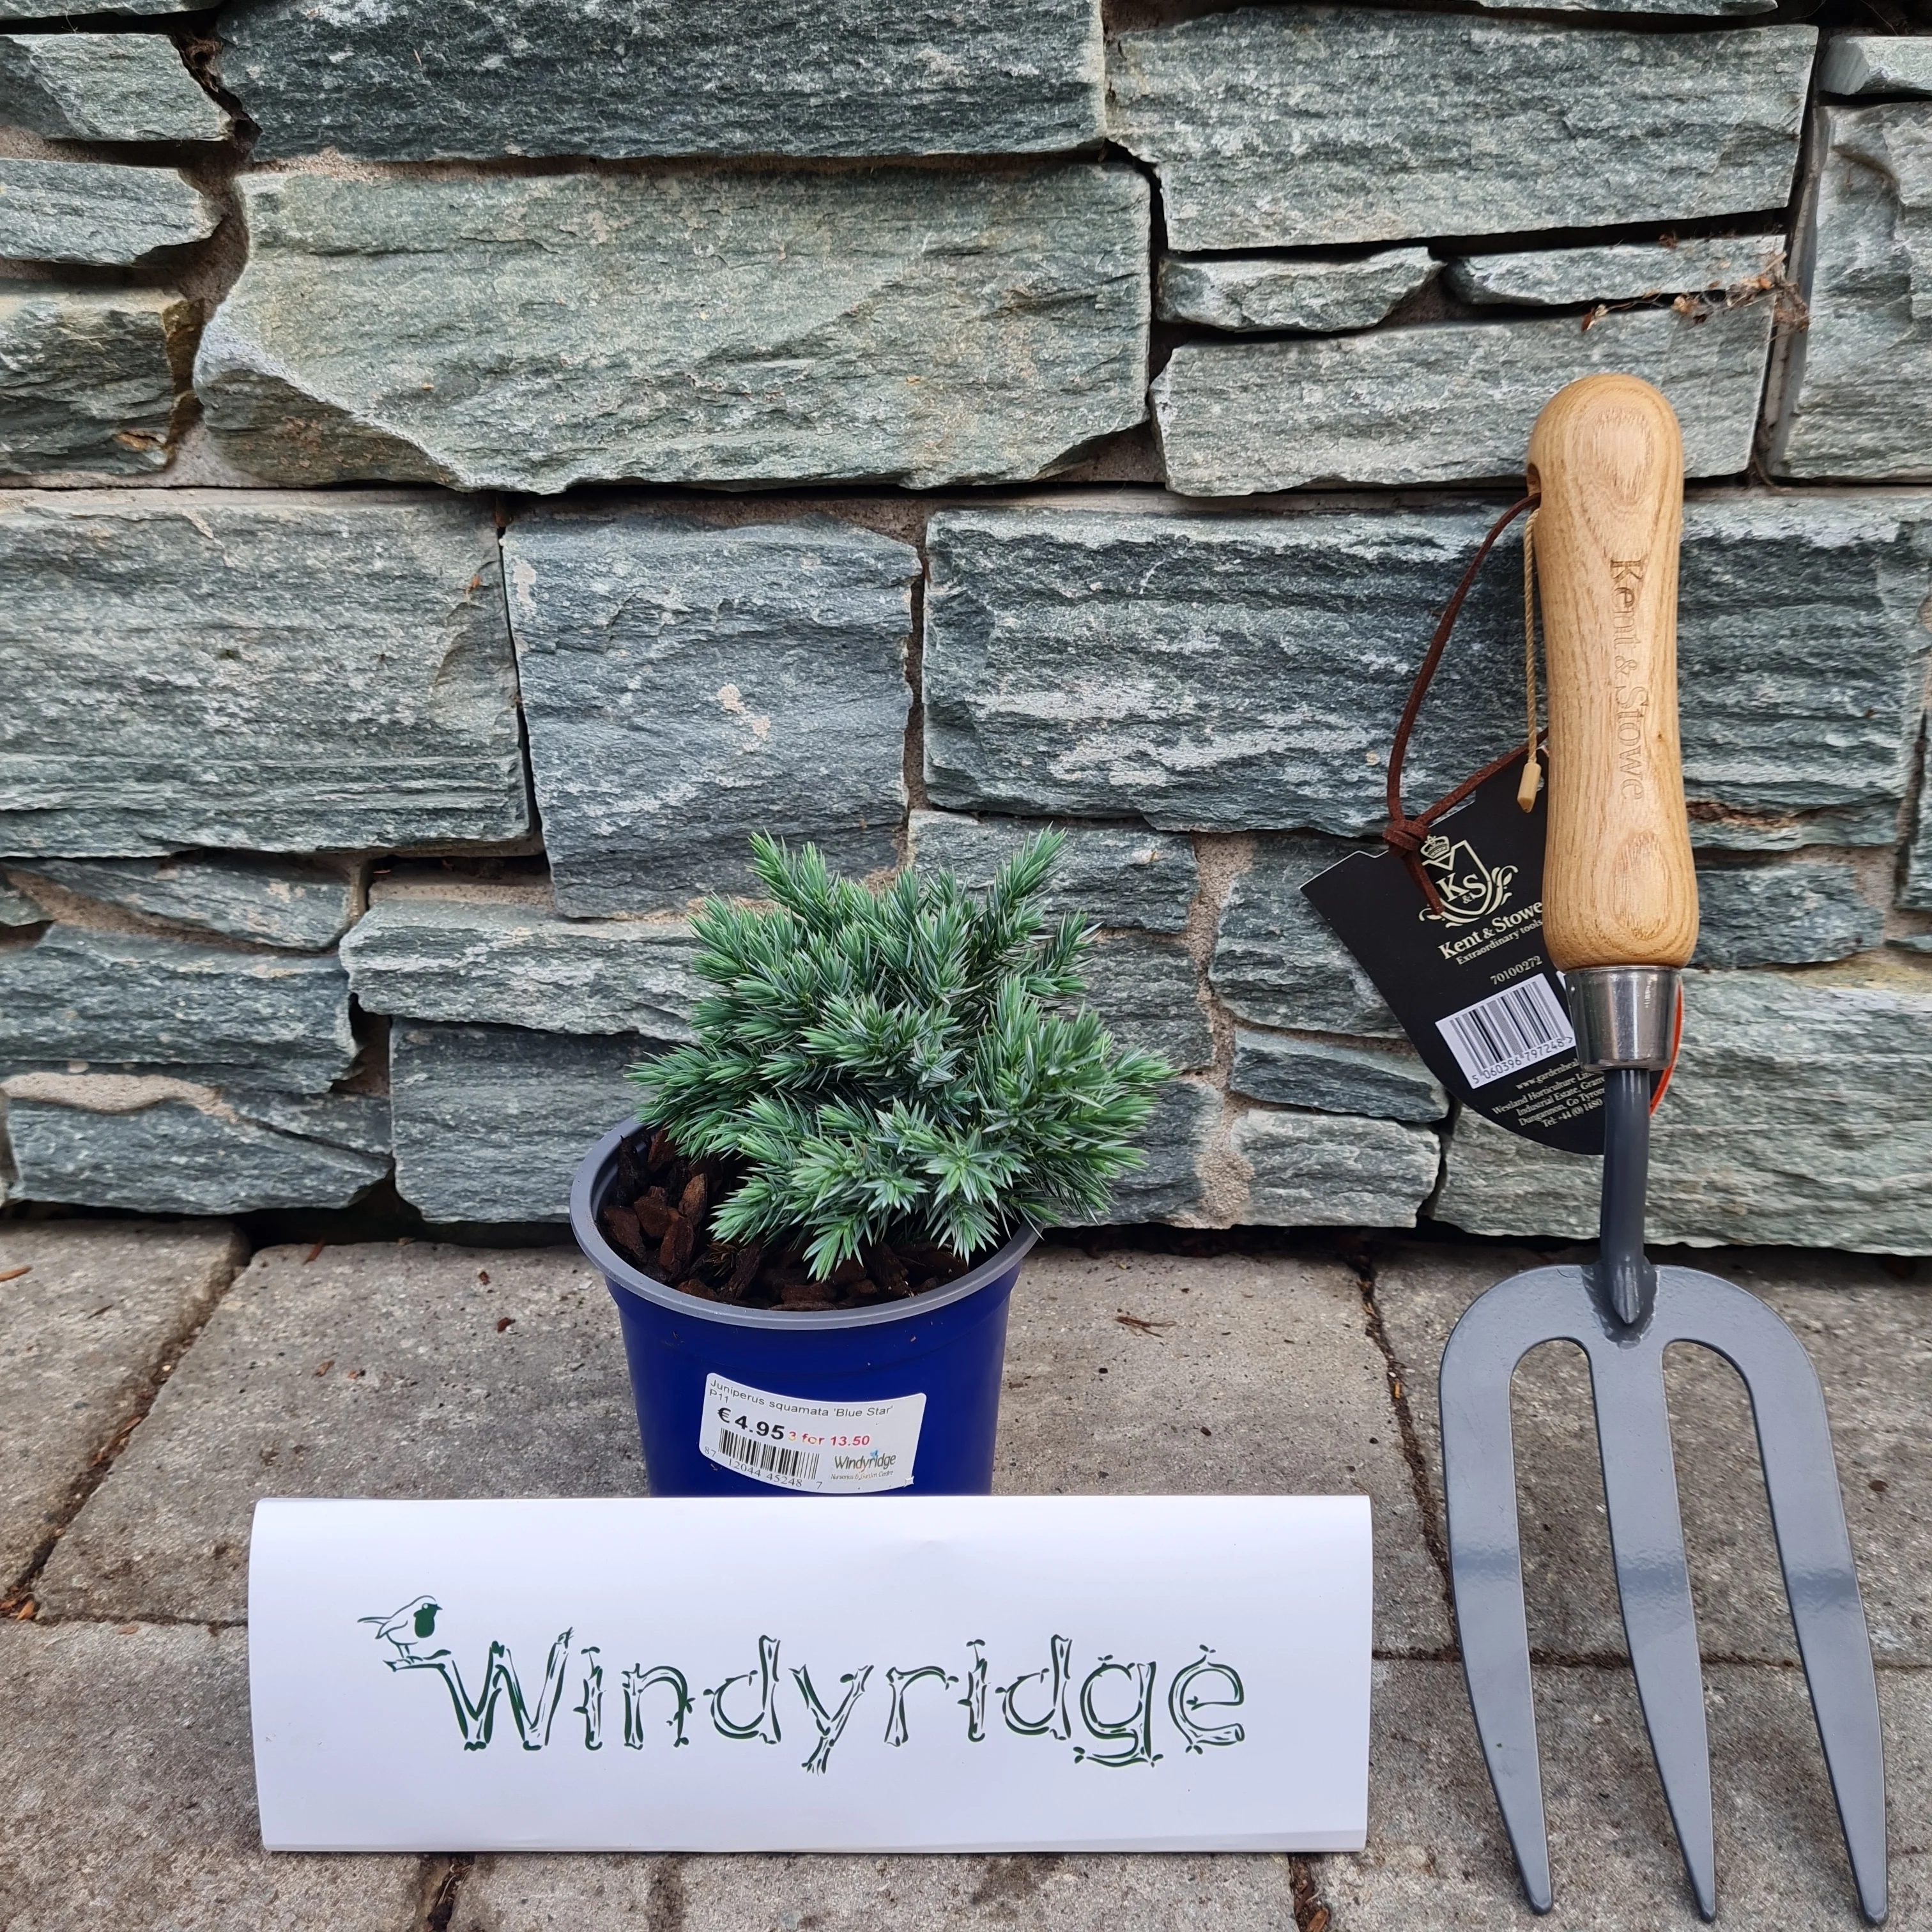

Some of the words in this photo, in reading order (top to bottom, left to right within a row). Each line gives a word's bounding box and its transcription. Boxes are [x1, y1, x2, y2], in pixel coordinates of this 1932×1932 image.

[1609, 559, 1643, 650] Kent
[1614, 655, 1637, 678] &
[1614, 686, 1649, 801] Stowe
[1438, 930, 1484, 959] Kent
[1482, 928, 1496, 939] &
[1491, 901, 1543, 931] Stowe
[1455, 930, 1520, 965] Extraordinary
[1519, 919, 1543, 934] tools
[1490, 955, 1543, 985] 70100272
[1471, 1075, 1480, 1085] 5
[1483, 1057, 1522, 1080] 060396
[1524, 1038, 1565, 1061] 797248
[1491, 1095, 1529, 1114] Westland
[1527, 1077, 1576, 1101] Horticulture
[1515, 1095, 1555, 1116] Industrial
[1566, 1098, 1579, 1107] Co
[709, 1388, 729, 1404] P11
[710, 1379, 765, 1405] Juniperus
[769, 1400, 829, 1417] squamata
[833, 1407, 862, 1418] 'Blue
[866, 1405, 893, 1416] Star'
[787, 1430, 797, 1442] 3
[801, 1433, 825, 1445] for
[830, 1435, 870, 1446] 13.50
[704, 1446, 717, 1458] 87
[728, 1457, 762, 1478] 12044
[765, 1472, 803, 1487] 45248
[815, 1481, 824, 1490] 7
[834, 1453, 896, 1473] Windyridge
[383, 1626, 1246, 1776] Windyridge
